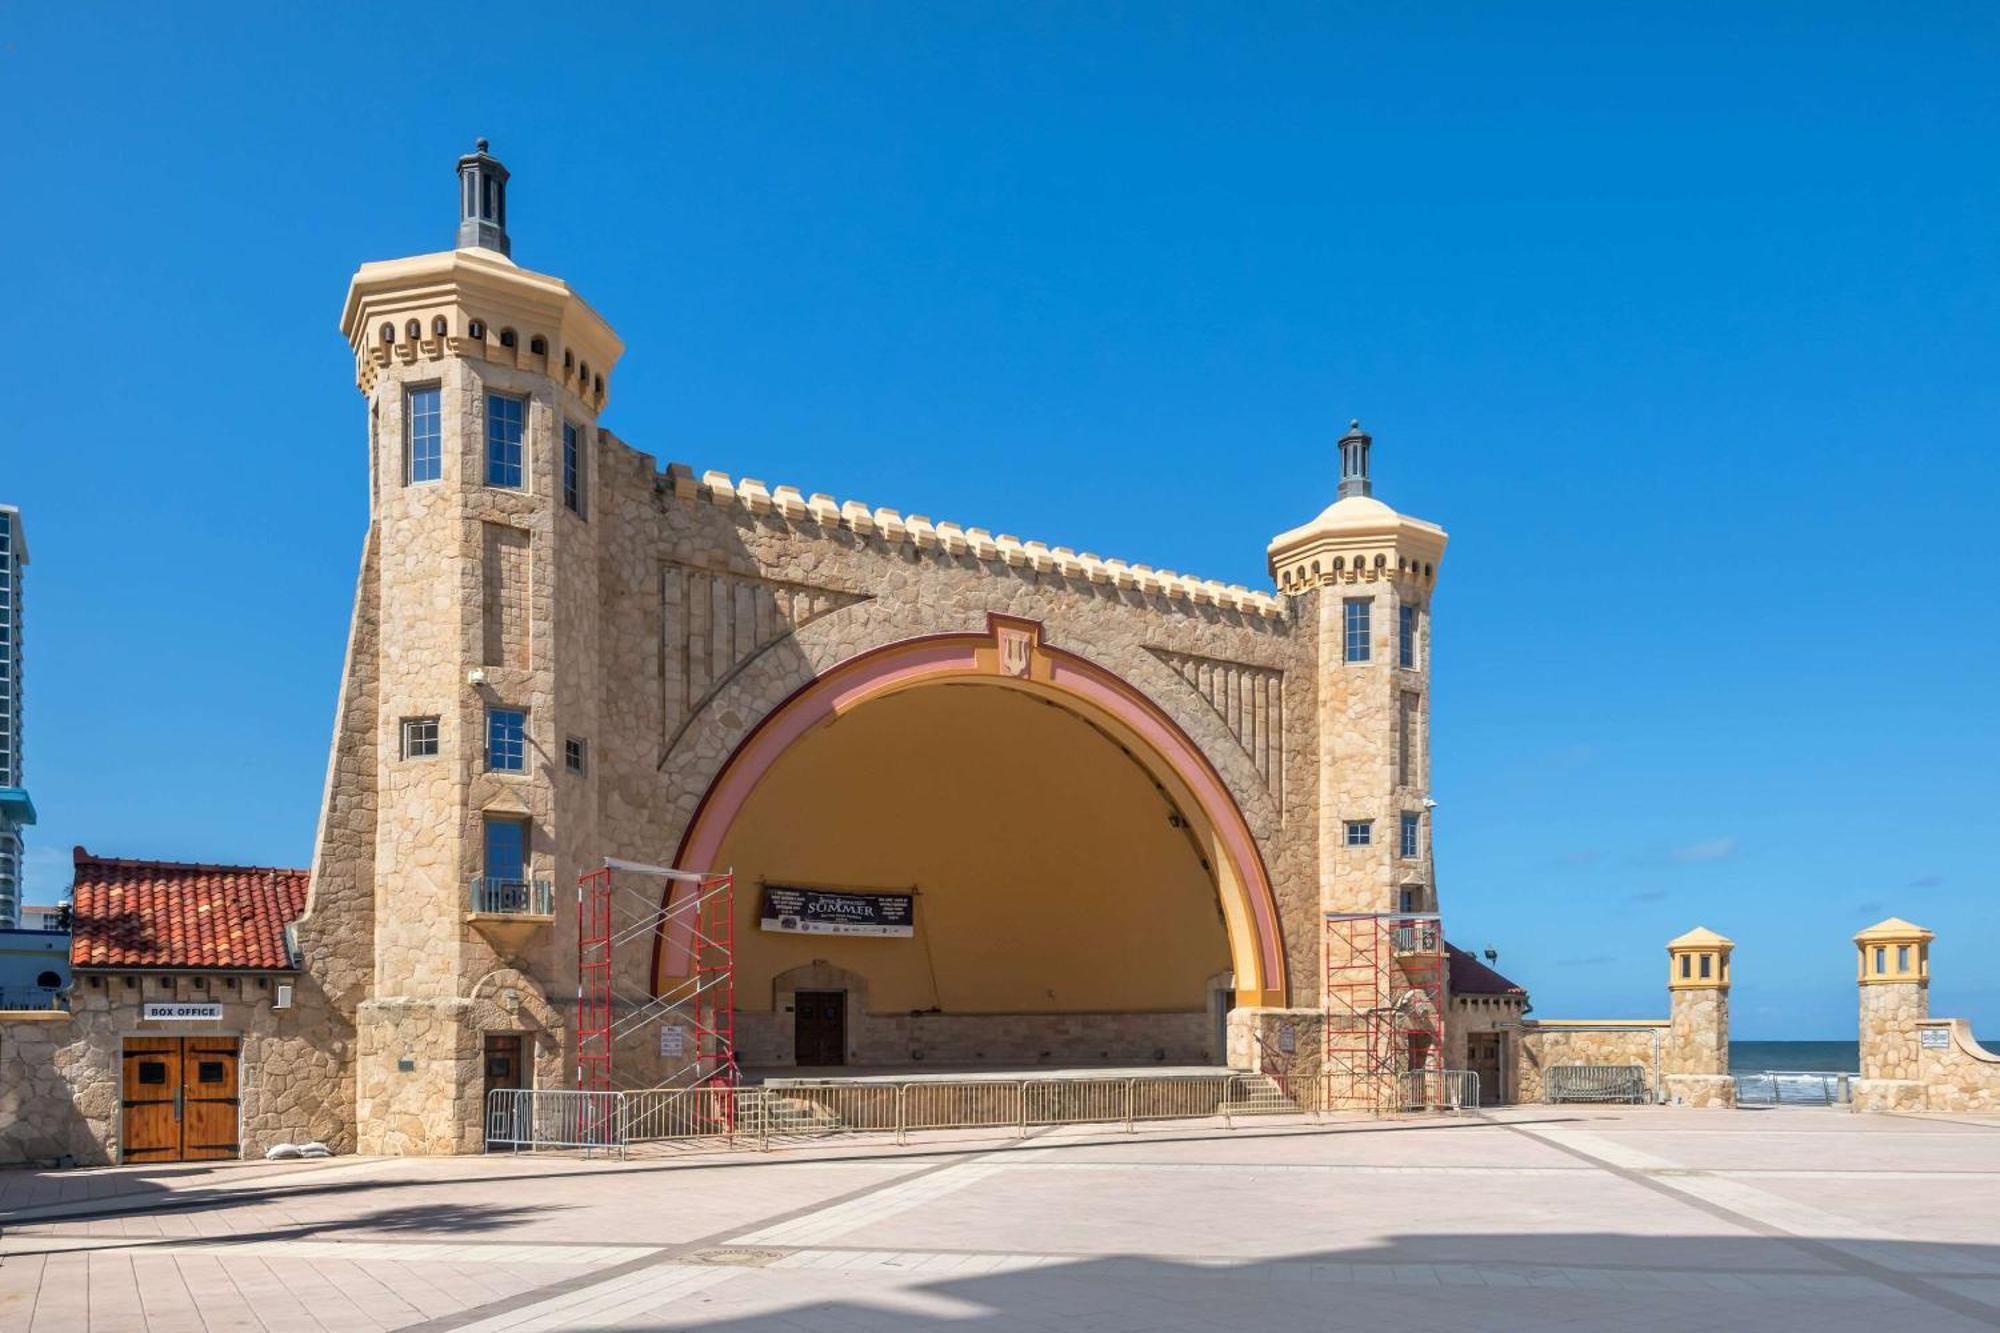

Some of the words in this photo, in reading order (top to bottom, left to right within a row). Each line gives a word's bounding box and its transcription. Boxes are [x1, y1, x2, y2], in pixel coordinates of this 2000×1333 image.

[807, 902, 874, 917] SUMMER
[151, 1008, 173, 1017] BOX
[177, 1008, 216, 1017] OFFICE
